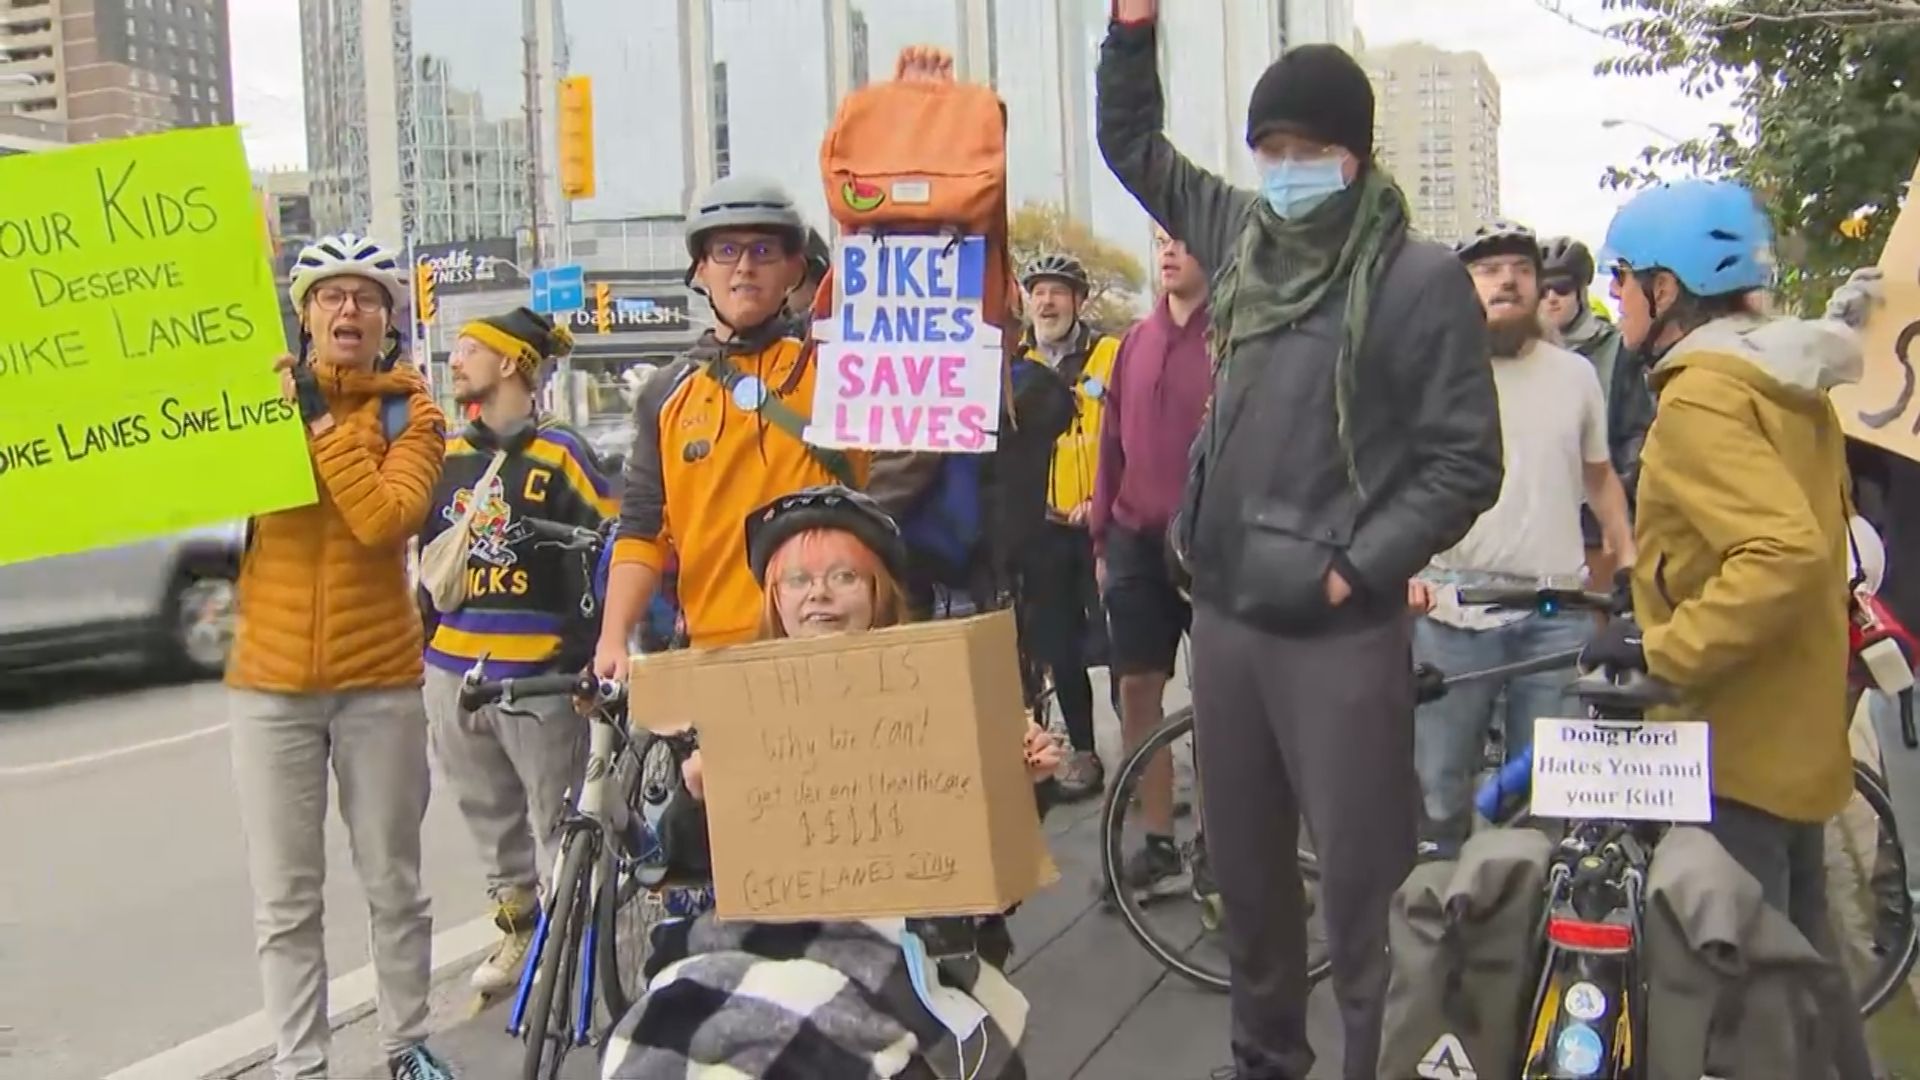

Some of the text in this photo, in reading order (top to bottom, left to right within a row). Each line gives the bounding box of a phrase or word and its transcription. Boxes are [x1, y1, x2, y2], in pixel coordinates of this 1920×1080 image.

[0, 160, 218, 258] OUR KIDS
[30, 260, 184, 308] DESERVE
[432, 269, 473, 284] TNESS
[844, 245, 954, 297] BIKE
[112, 304, 254, 359] LANES
[843, 303, 975, 343] LANES
[838, 354, 966, 398] SAVE
[57, 413, 151, 462] LANES
[161, 397, 219, 440] SAVE
[222, 390, 296, 431] LIVES
[835, 403, 986, 450] LIVES
[524, 468, 550, 501] C
[468, 567, 528, 600] CKS
[1561, 727, 1679, 747] Doug Ford
[1539, 756, 1702, 779] Hates You and
[1566, 788, 1674, 808] your Kid!
